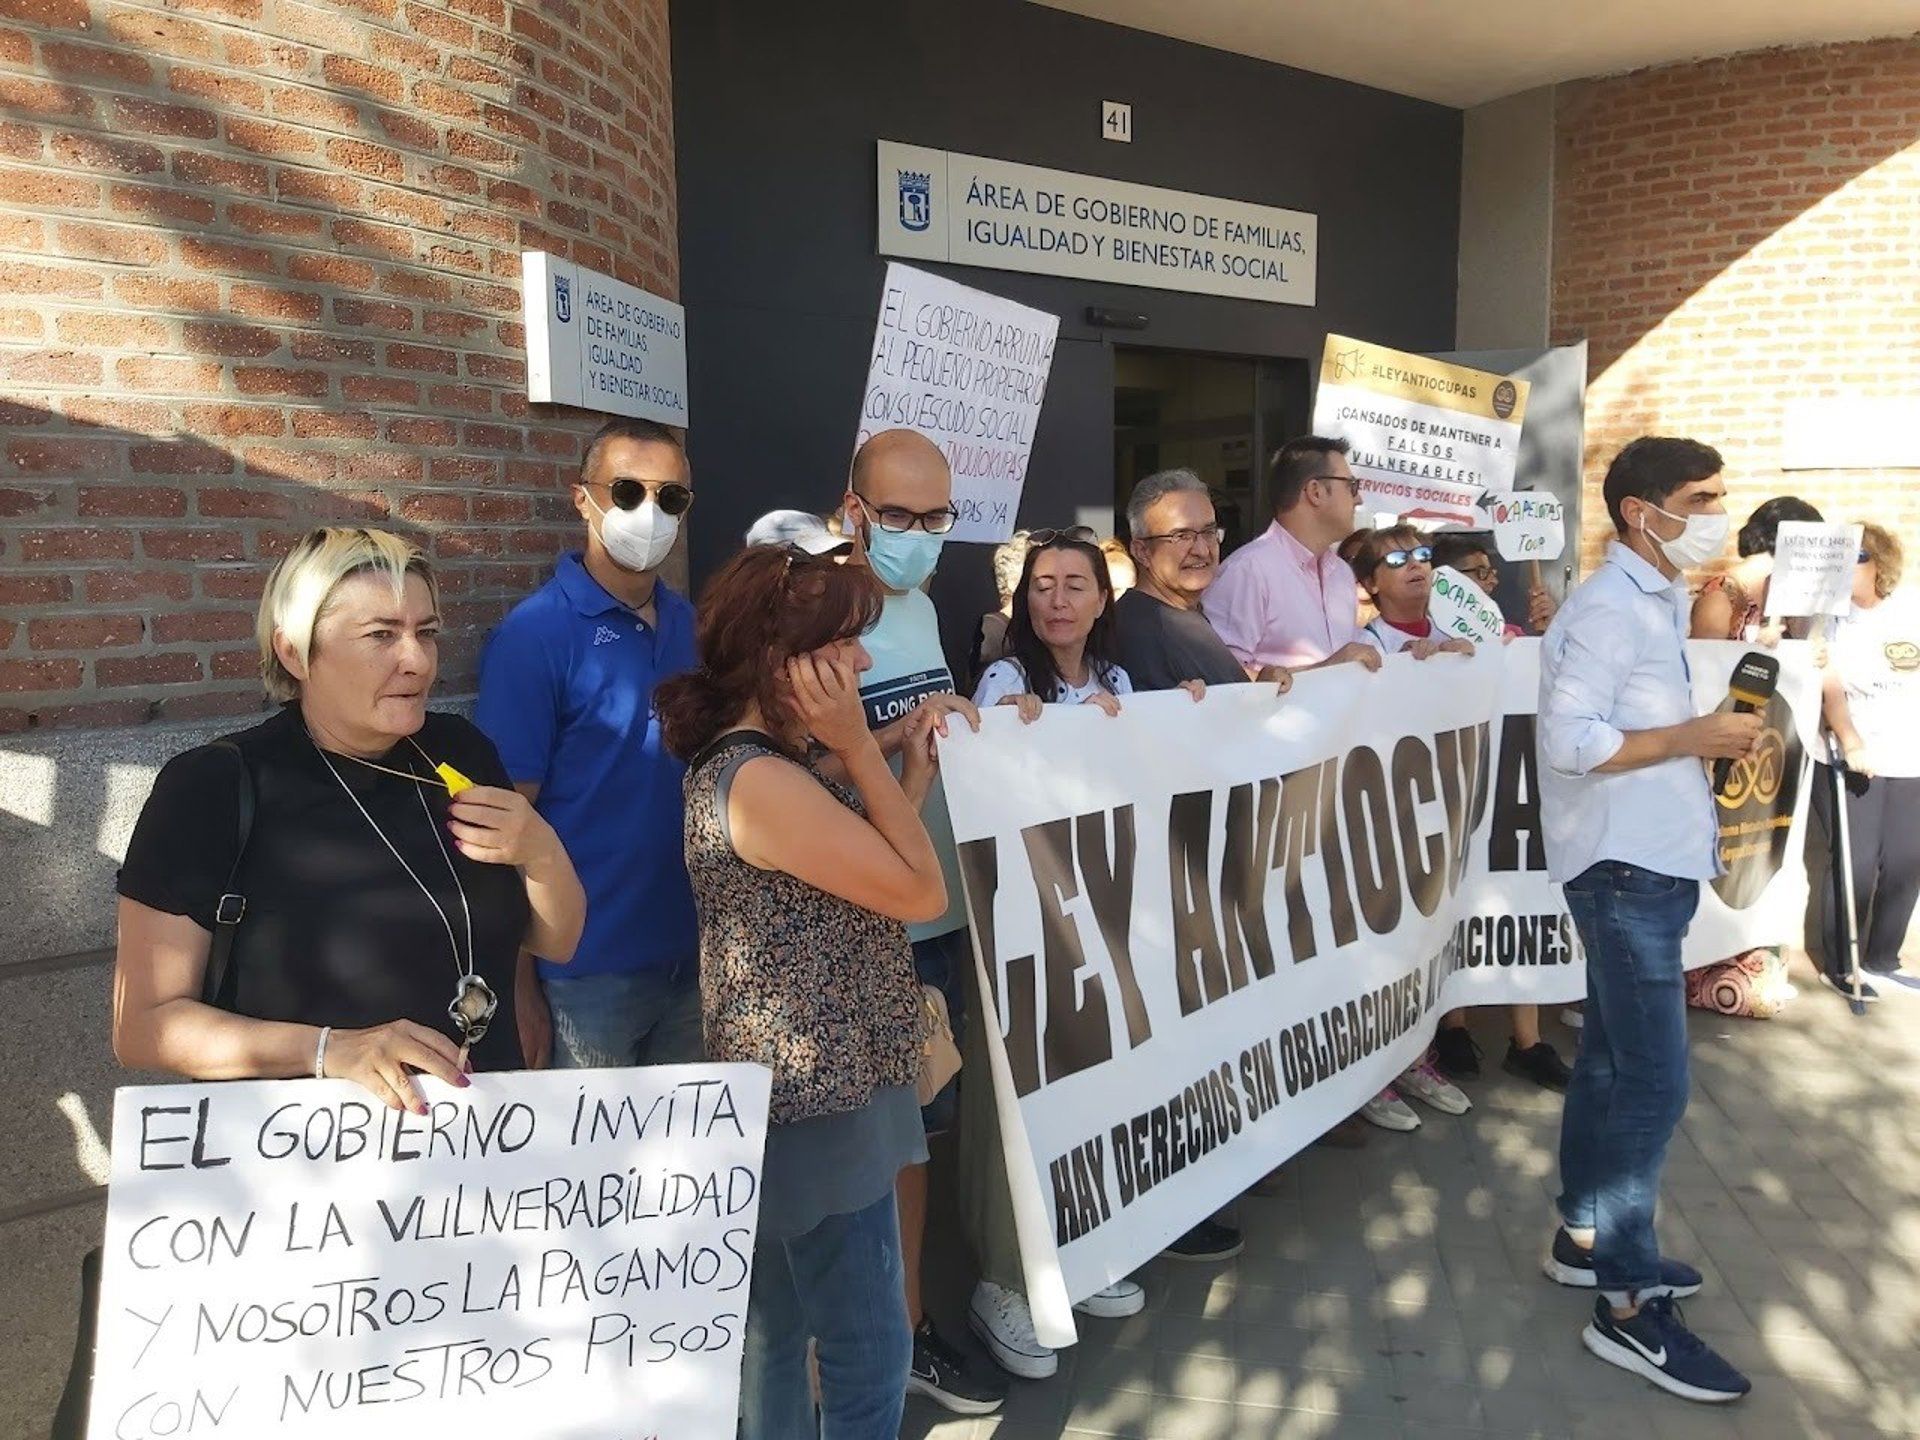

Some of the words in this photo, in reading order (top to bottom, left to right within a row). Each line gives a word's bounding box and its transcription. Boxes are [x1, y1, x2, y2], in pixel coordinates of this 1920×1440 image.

[1105, 109, 1128, 135] 41
[966, 176, 1028, 212] ÁREA
[1036, 191, 1066, 217] DE
[1073, 197, 1186, 234] GOBIERNO
[1193, 215, 1219, 239] DE
[1225, 221, 1306, 255] FAMILIAS,
[968, 219, 1088, 255] IGUALDAD
[1092, 235, 1105, 257] Y
[1113, 238, 1216, 273] BIENESTAR
[1222, 254, 1289, 283] SOCIAL
[586, 285, 615, 318] ÁREA
[617, 301, 632, 322] DE
[633, 307, 681, 340] GOBIERNO
[587, 316, 603, 338] DE
[883, 288, 907, 333] EL
[915, 303, 992, 352] GOBIERNO
[588, 344, 643, 375] IGUALDAD
[871, 334, 895, 376] AL
[589, 370, 597, 390] Y
[600, 372, 652, 403] BIENESTAR
[652, 386, 684, 410] SOCIAL
[1371, 365, 1477, 399] #LEYANTIOCUPAS
[865, 385, 899, 421] CON
[894, 392, 920, 425] SU
[918, 393, 976, 434] ESCUDO
[976, 407, 1028, 445] SOCIAL
[1337, 406, 1408, 431] ¡CANSADOS
[1410, 420, 1426, 435] DE
[1429, 424, 1492, 447] MANTENER
[1494, 438, 1502, 449] A
[1352, 450, 1483, 486] VULNERABLES!
[1387, 435, 1455, 459] FALSOS
[989, 501, 1008, 525] YA
[1355, 479, 1413, 498] ERVICIOS
[1415, 488, 1472, 507] SOCIALES
[874, 695, 916, 722] LONG
[957, 803, 1153, 1099] LEY
[1168, 713, 1548, 1018] ANTIOCUPA
[1050, 1134, 1112, 1248] HAY
[1111, 1061, 1242, 1208] DERECHOS
[1239, 1030, 1280, 1122] SIN
[1279, 967, 1422, 1098] OBLIGACIONES
[139, 1097, 232, 1171] EL
[257, 1099, 536, 1165] GOBIERNO
[128, 1203, 256, 1270] CON
[283, 1201, 355, 1253] LA
[125, 1304, 174, 1370] Y
[193, 1275, 449, 1355] NOSOTROS
[461, 1261, 521, 1315] LA
[536, 1227, 753, 1309] PAGAMOS
[114, 1385, 241, 1440] CON
[279, 1337, 552, 1423] NUESTROS
